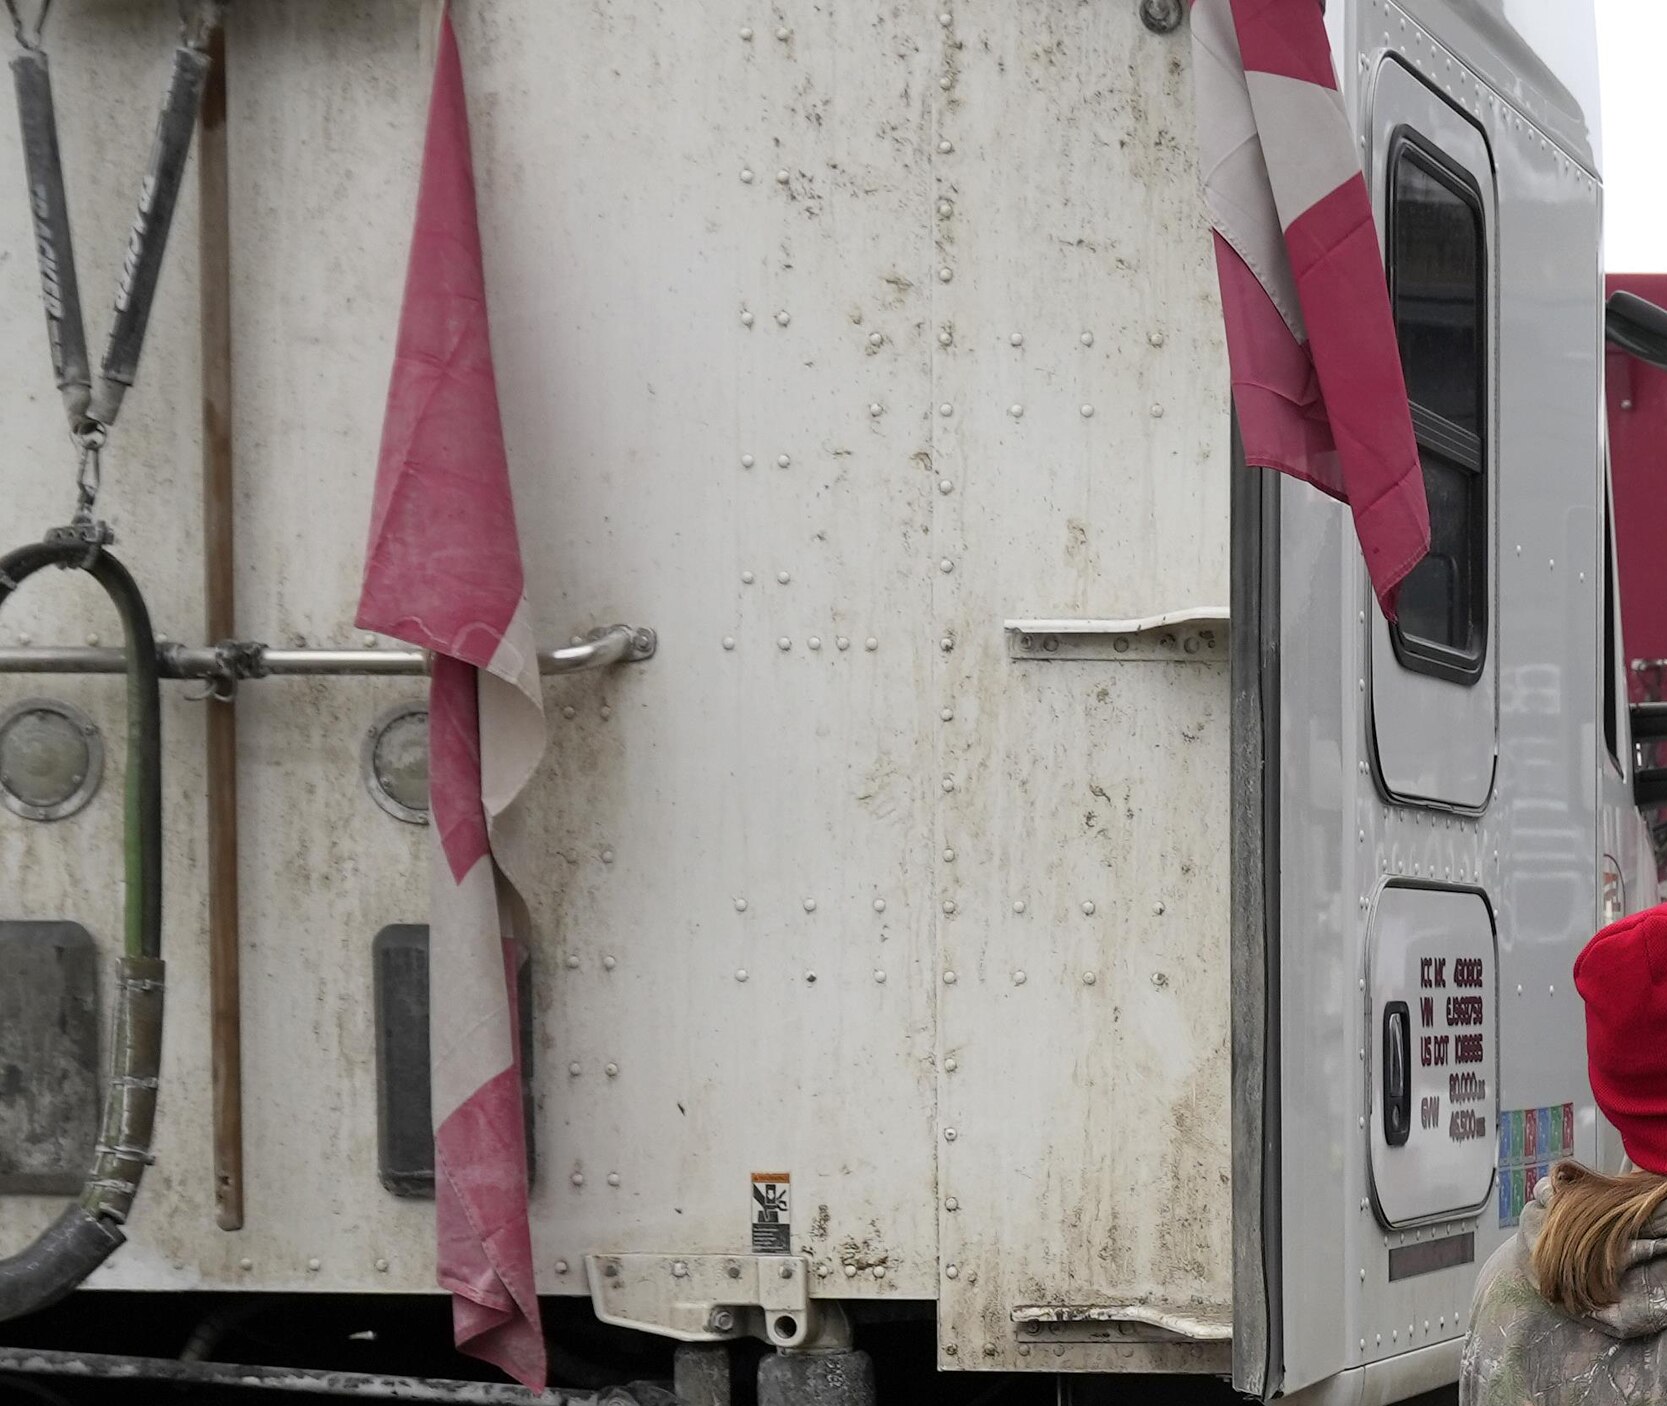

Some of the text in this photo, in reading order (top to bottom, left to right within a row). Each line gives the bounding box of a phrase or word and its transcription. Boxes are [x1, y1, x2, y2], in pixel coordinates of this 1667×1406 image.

[1420, 996, 1434, 1028] VIN
[1421, 1035, 1432, 1067] US
[1433, 1035, 1450, 1066] DOT
